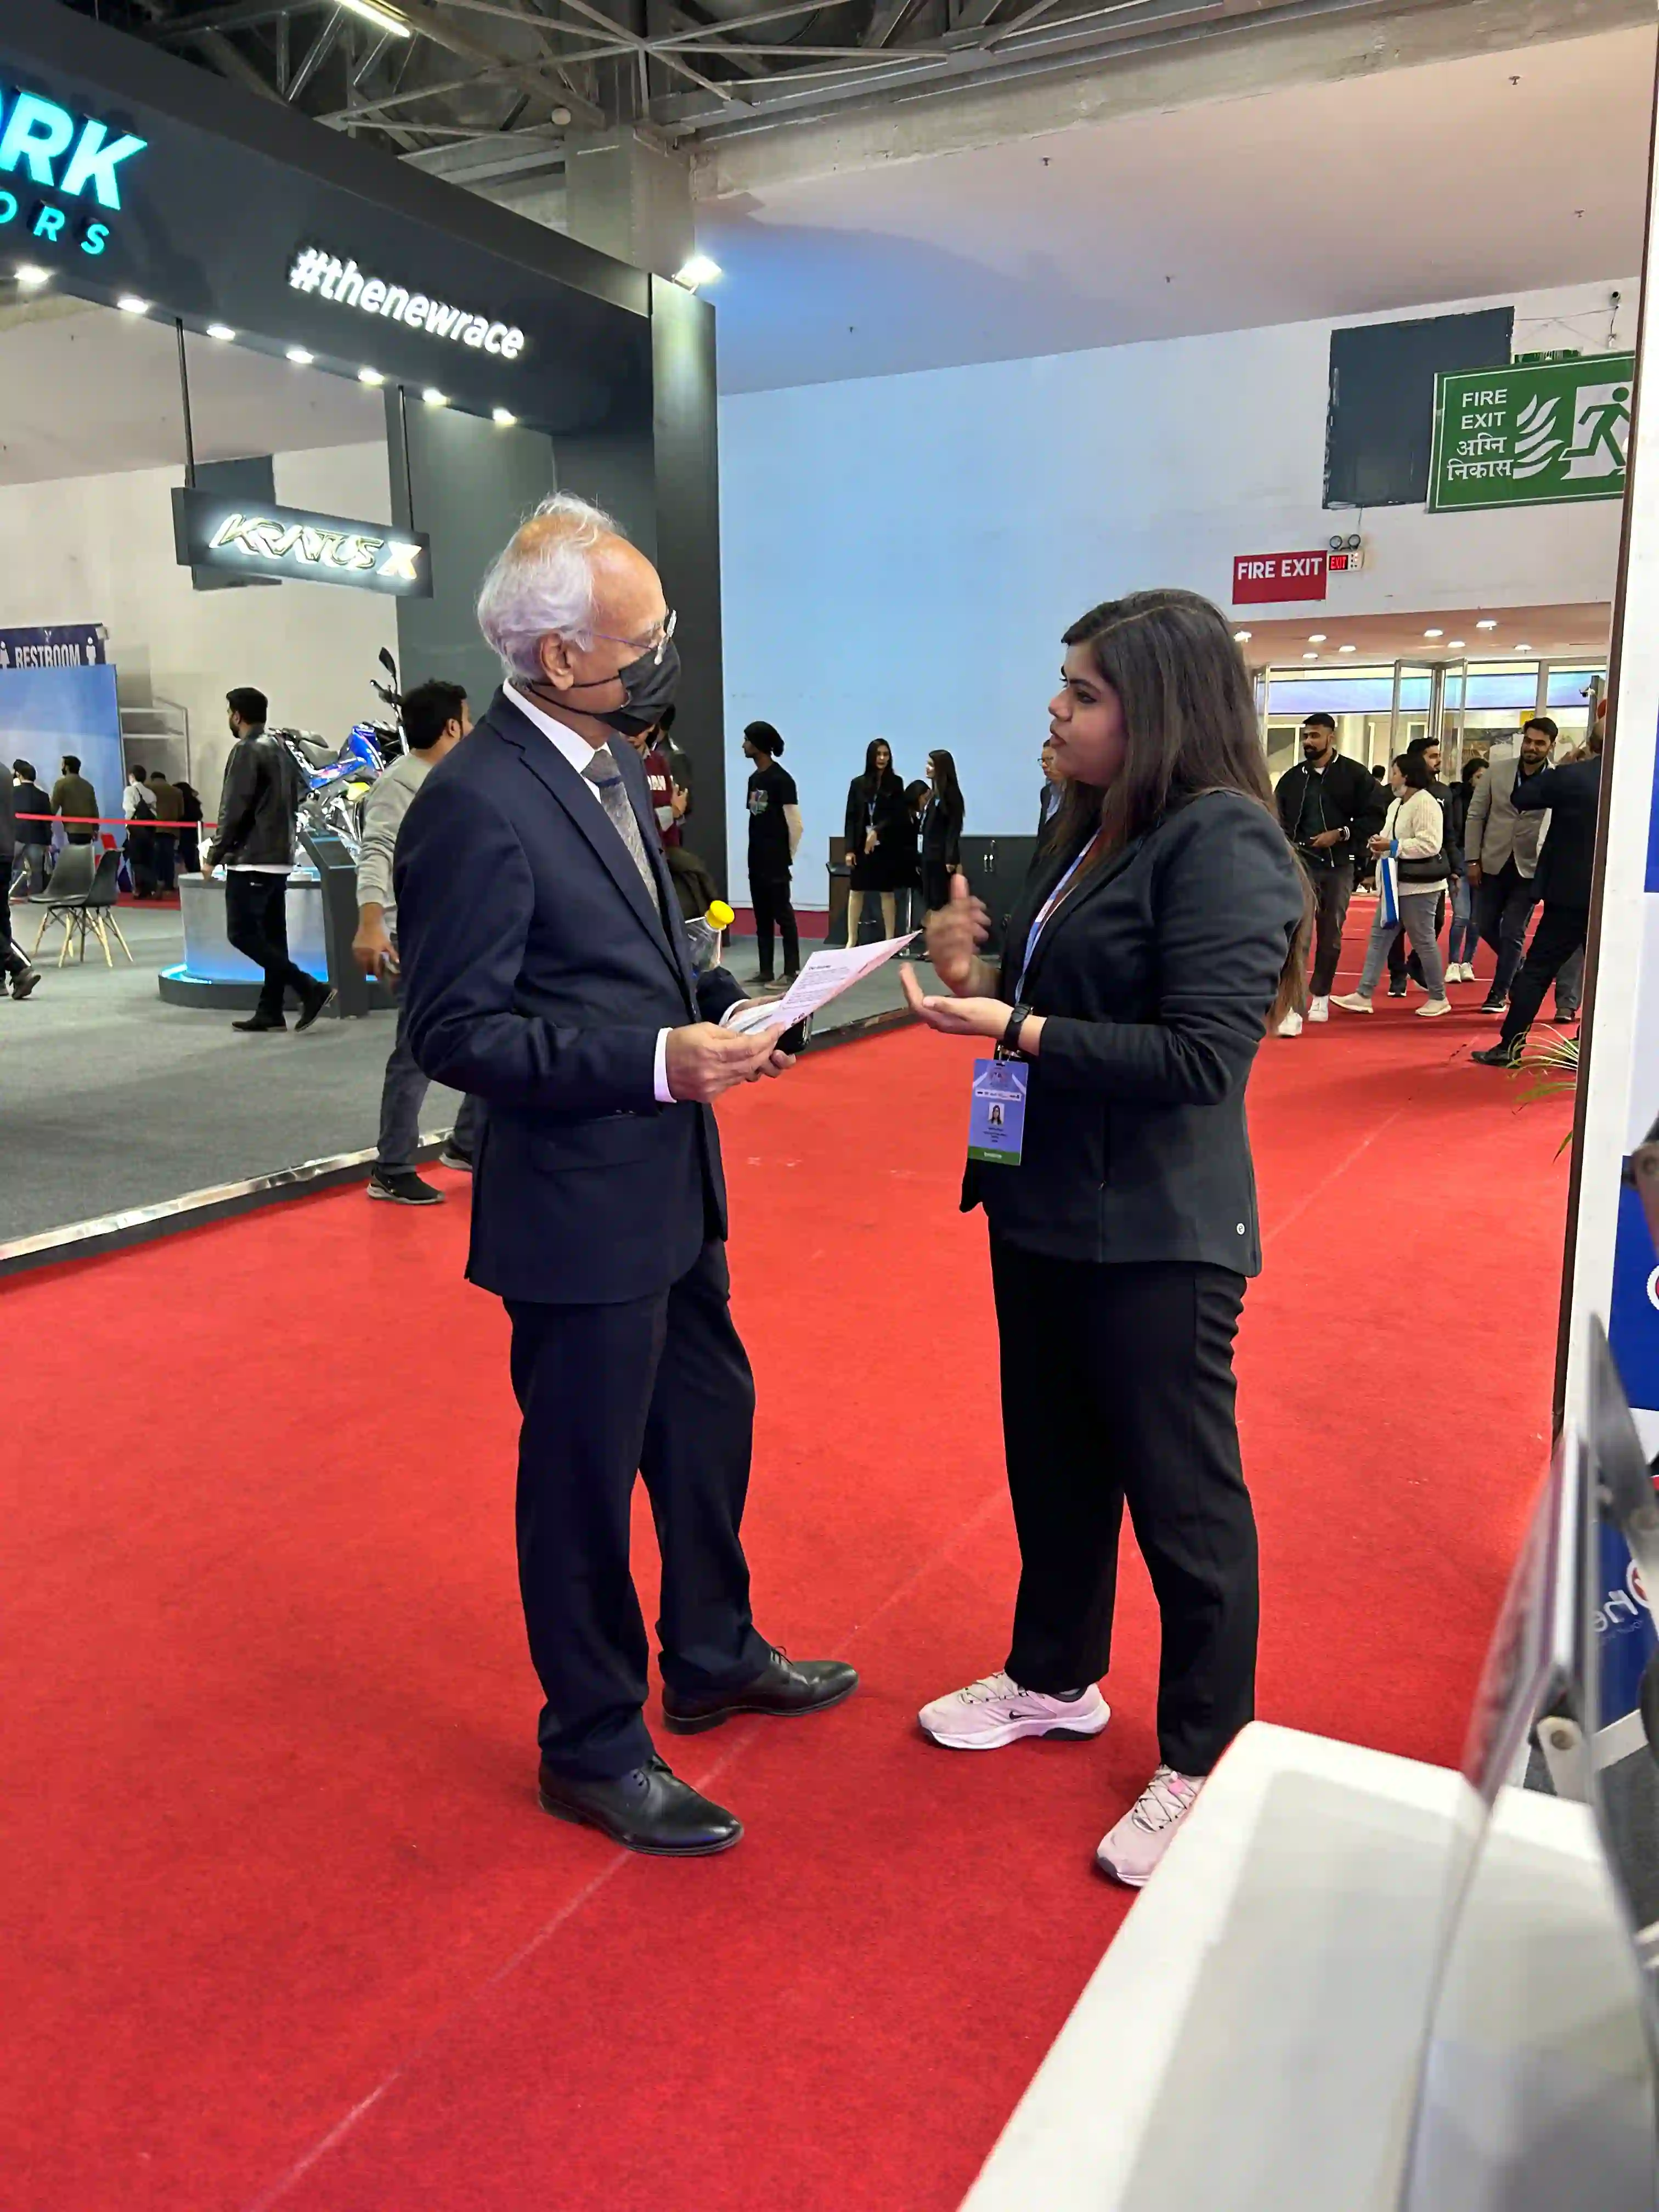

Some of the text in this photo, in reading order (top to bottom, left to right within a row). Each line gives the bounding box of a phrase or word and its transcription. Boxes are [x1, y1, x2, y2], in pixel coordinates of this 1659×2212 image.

[0, 92, 148, 211] RK
[290, 247, 524, 359] #thenewrace
[1462, 389, 1508, 408] FIRE
[1462, 411, 1506, 430] EXIT
[1457, 432, 1507, 456] अग्नि
[1447, 458, 1514, 481] निकास
[376, 541, 422, 580] X
[1238, 557, 1323, 580] FIRE EXIT
[1330, 556, 1346, 569] EXIT
[15, 643, 81, 669] RESTROOM
